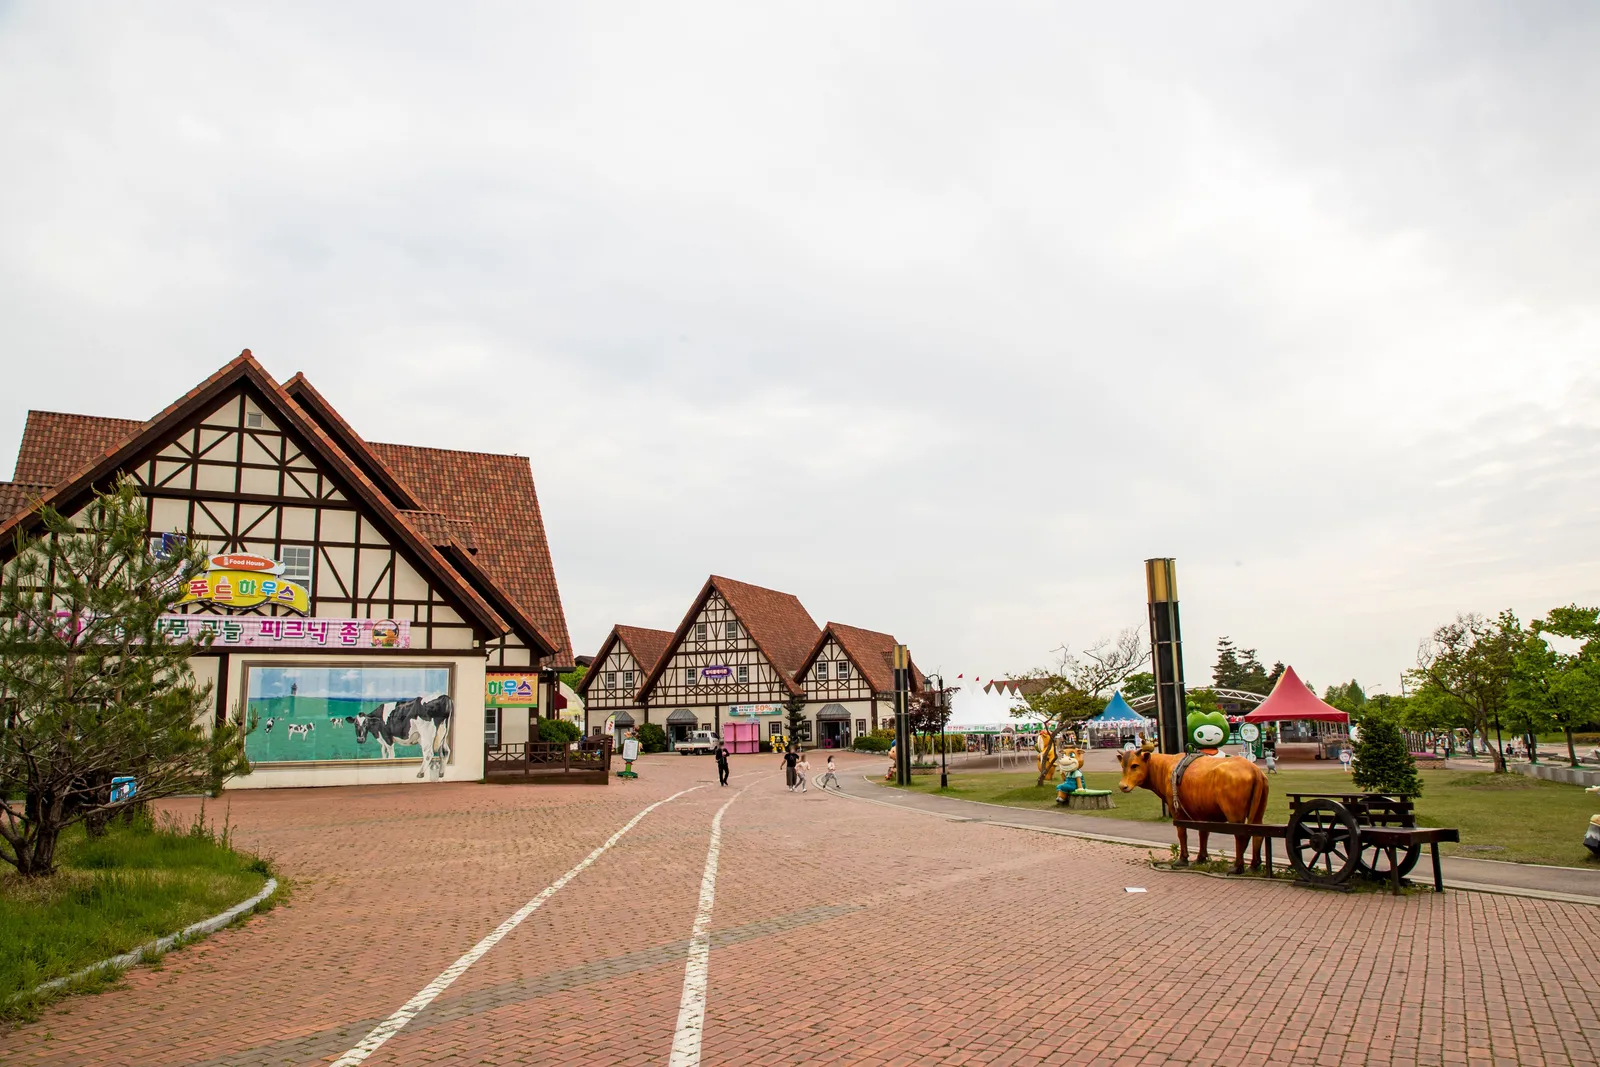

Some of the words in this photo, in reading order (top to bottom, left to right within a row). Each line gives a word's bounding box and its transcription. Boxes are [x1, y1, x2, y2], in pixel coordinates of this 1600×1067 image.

[189, 578, 295, 601] 푸드하우스
[260, 620, 327, 644] 피크닉
[340, 621, 359, 643] 존
[488, 680, 532, 696] 하우스
[755, 704, 772, 712] 50%
